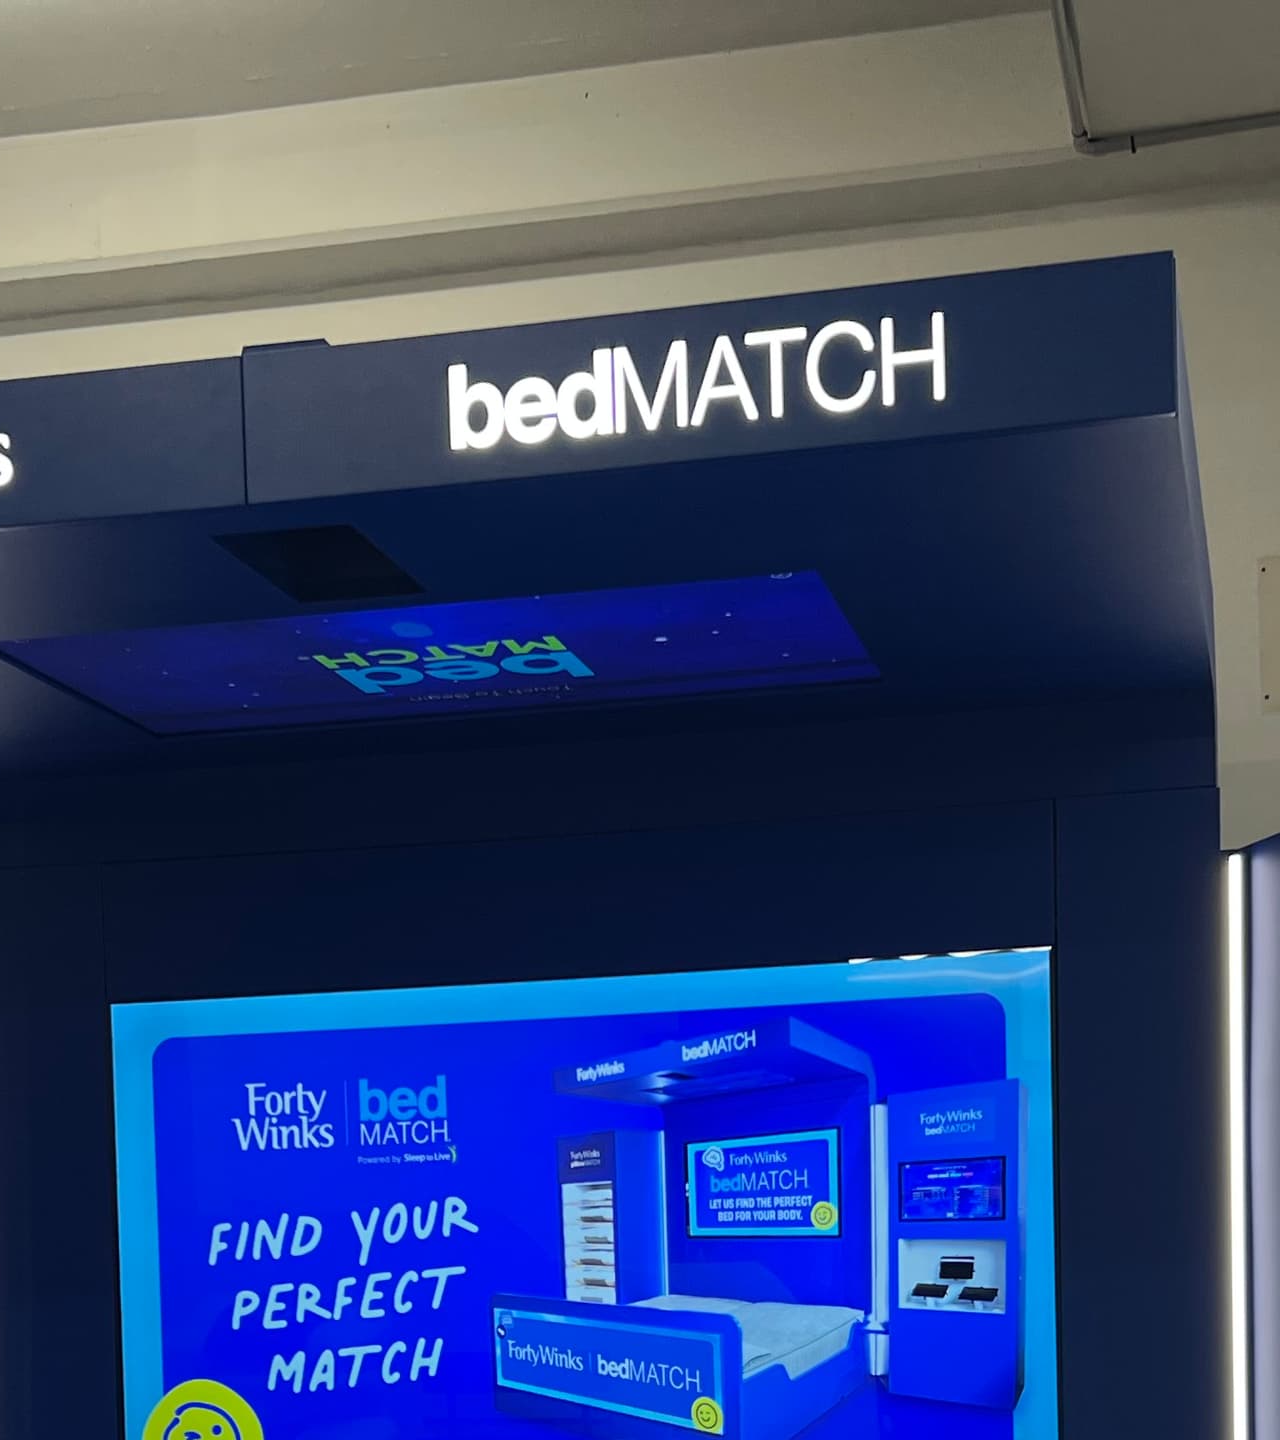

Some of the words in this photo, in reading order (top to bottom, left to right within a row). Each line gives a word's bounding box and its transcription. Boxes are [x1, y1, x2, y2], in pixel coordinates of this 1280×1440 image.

[446, 310, 947, 452] bedMATCH
[335, 650, 595, 694] bed
[244, 1082, 327, 1122] Forty
[358, 1074, 448, 1122] bed
[231, 1115, 335, 1151] Winks
[709, 1168, 809, 1193] bedMATCH
[709, 1199, 722, 1210] LET
[723, 1198, 734, 1209] US
[736, 1197, 755, 1209] FIND
[756, 1196, 772, 1208] THE
[773, 1195, 813, 1208] PERFECT
[717, 1211, 734, 1222] BED
[735, 1210, 752, 1221] FOR
[752, 1210, 776, 1221] YOUR
[777, 1209, 804, 1221] BODY.
[208, 1212, 323, 1266] FIND
[350, 1196, 480, 1266] YOUR
[231, 1265, 467, 1330] PERFECT
[266, 1337, 444, 1394] MATCH
[597, 1353, 701, 1393] bedMATCH
